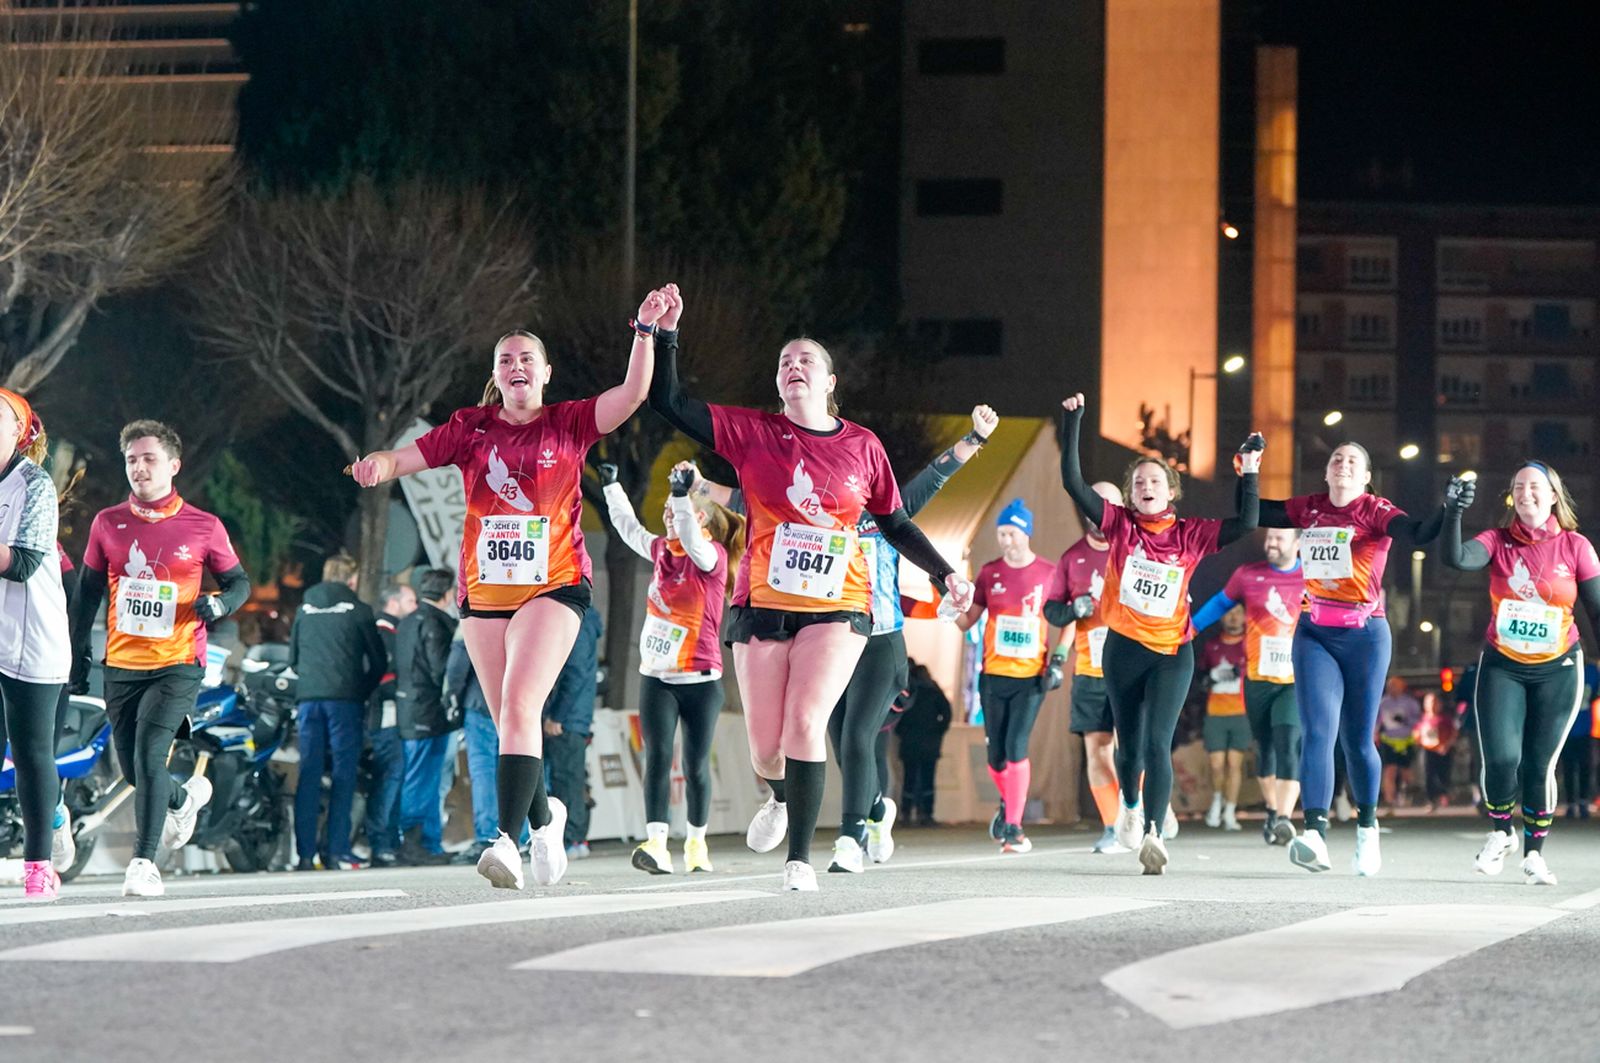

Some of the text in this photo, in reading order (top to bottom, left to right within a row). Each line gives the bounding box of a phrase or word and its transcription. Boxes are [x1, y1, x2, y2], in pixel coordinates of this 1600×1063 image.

[501, 483, 518, 500] 43
[800, 497, 819, 516] 43
[487, 540, 535, 561] 3646
[1310, 545, 1340, 561] 2212
[785, 549, 834, 575] 3647
[1133, 578, 1168, 599] 4512
[126, 598, 163, 618] 7609
[1508, 619, 1548, 638] 4325
[646, 635, 671, 655] 6739
